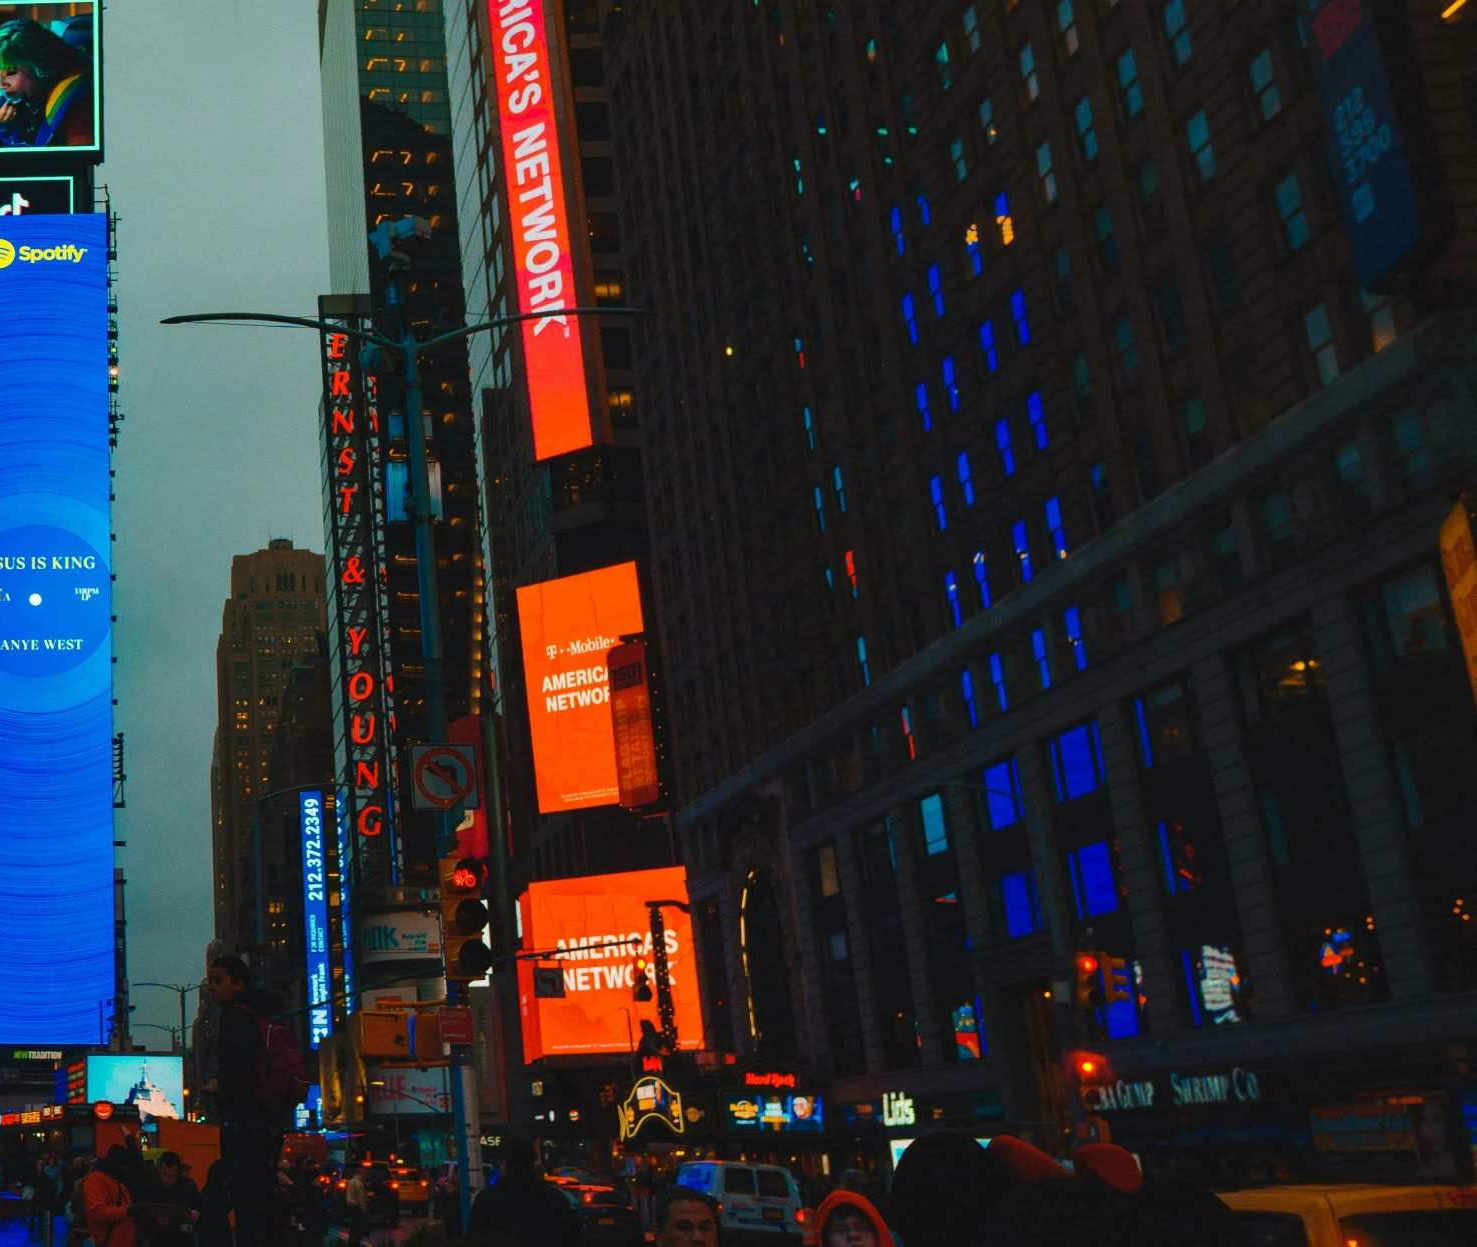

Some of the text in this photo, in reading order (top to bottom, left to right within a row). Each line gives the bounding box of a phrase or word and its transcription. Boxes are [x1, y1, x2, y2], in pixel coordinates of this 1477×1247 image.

[18, 244, 85, 263] Spotify
[31, 556, 47, 570] IS
[52, 555, 96, 570] KING
[329, 333, 383, 837] ERNST & YOUNG
[44, 639, 84, 651] WEST
[305, 798, 323, 902] 212.372.2349
[882, 1091, 916, 1127] Lids
